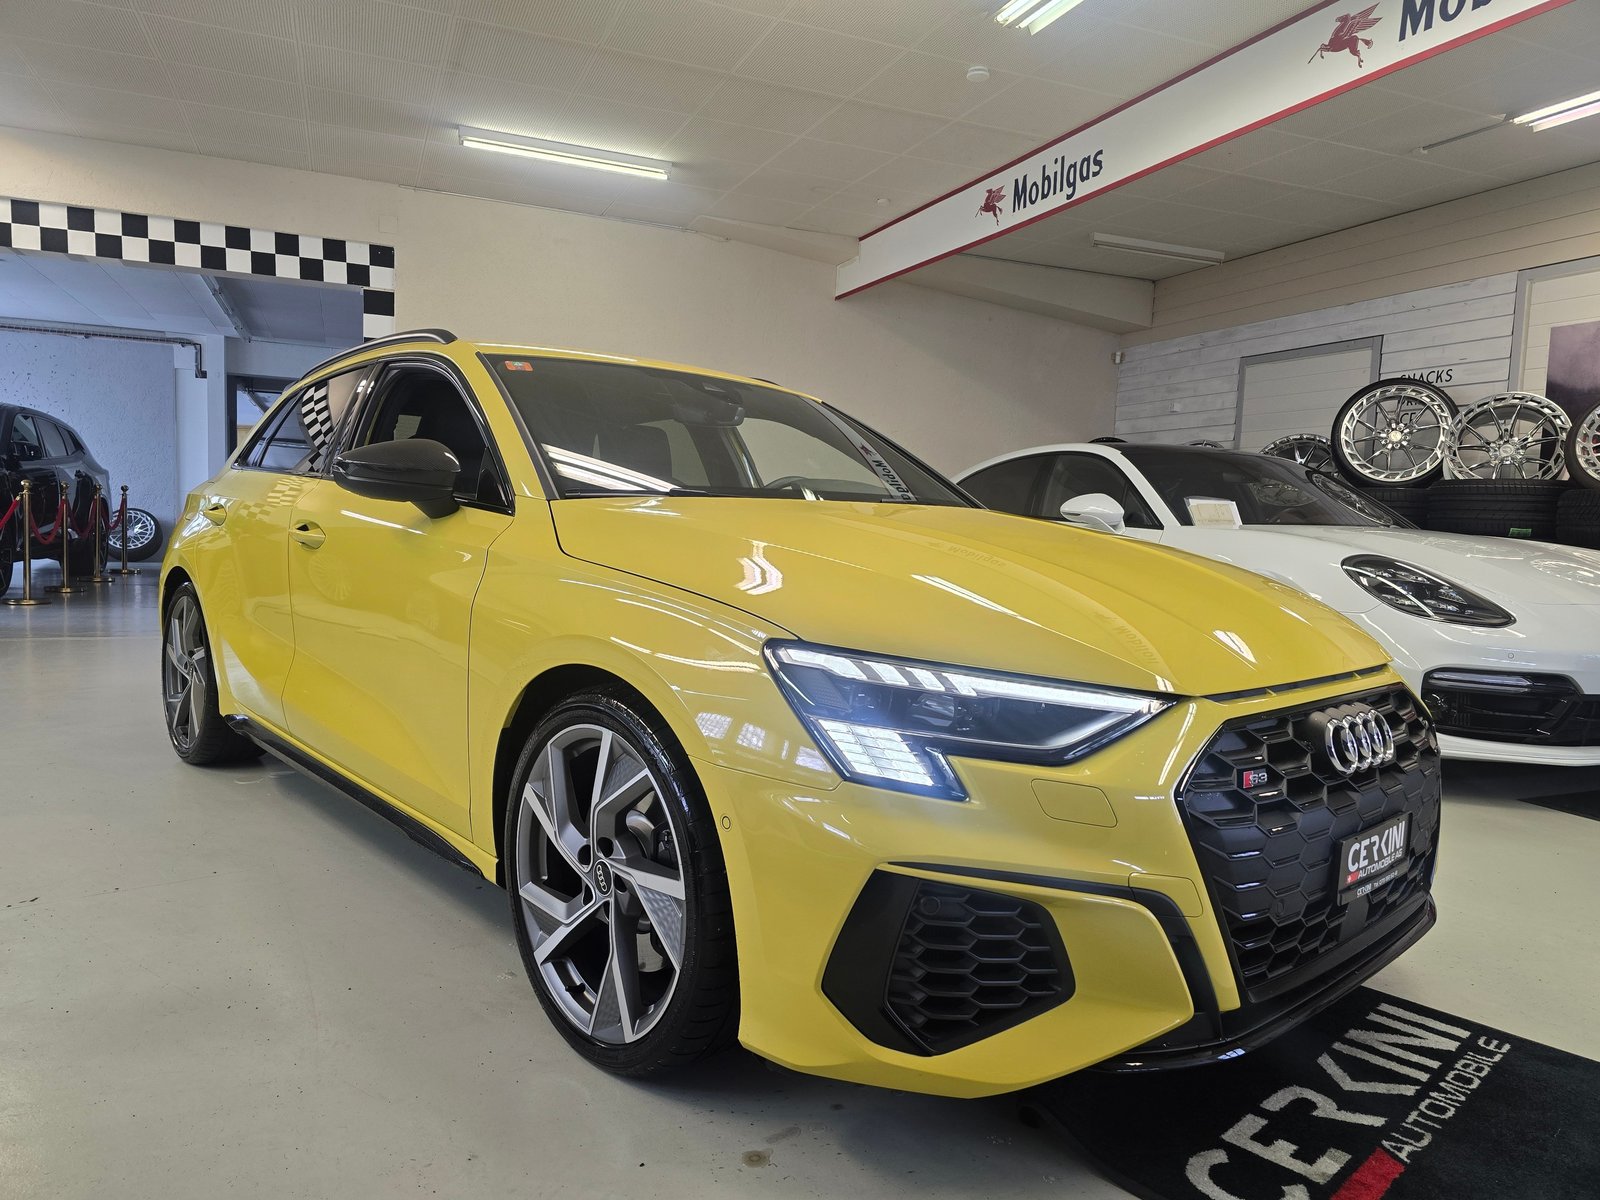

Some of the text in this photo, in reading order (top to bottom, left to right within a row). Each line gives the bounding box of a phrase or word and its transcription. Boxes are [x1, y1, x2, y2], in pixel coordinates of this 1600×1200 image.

[1398, 0, 1492, 42] Mo
[1012, 149, 1103, 213] Mobilgas
[1348, 821, 1405, 872] CERKINI
[1358, 852, 1395, 879] AUTOMOBILE
[1185, 1002, 1471, 1200] CERKINI
[1382, 1035, 1513, 1163] AUTOMOBILE
